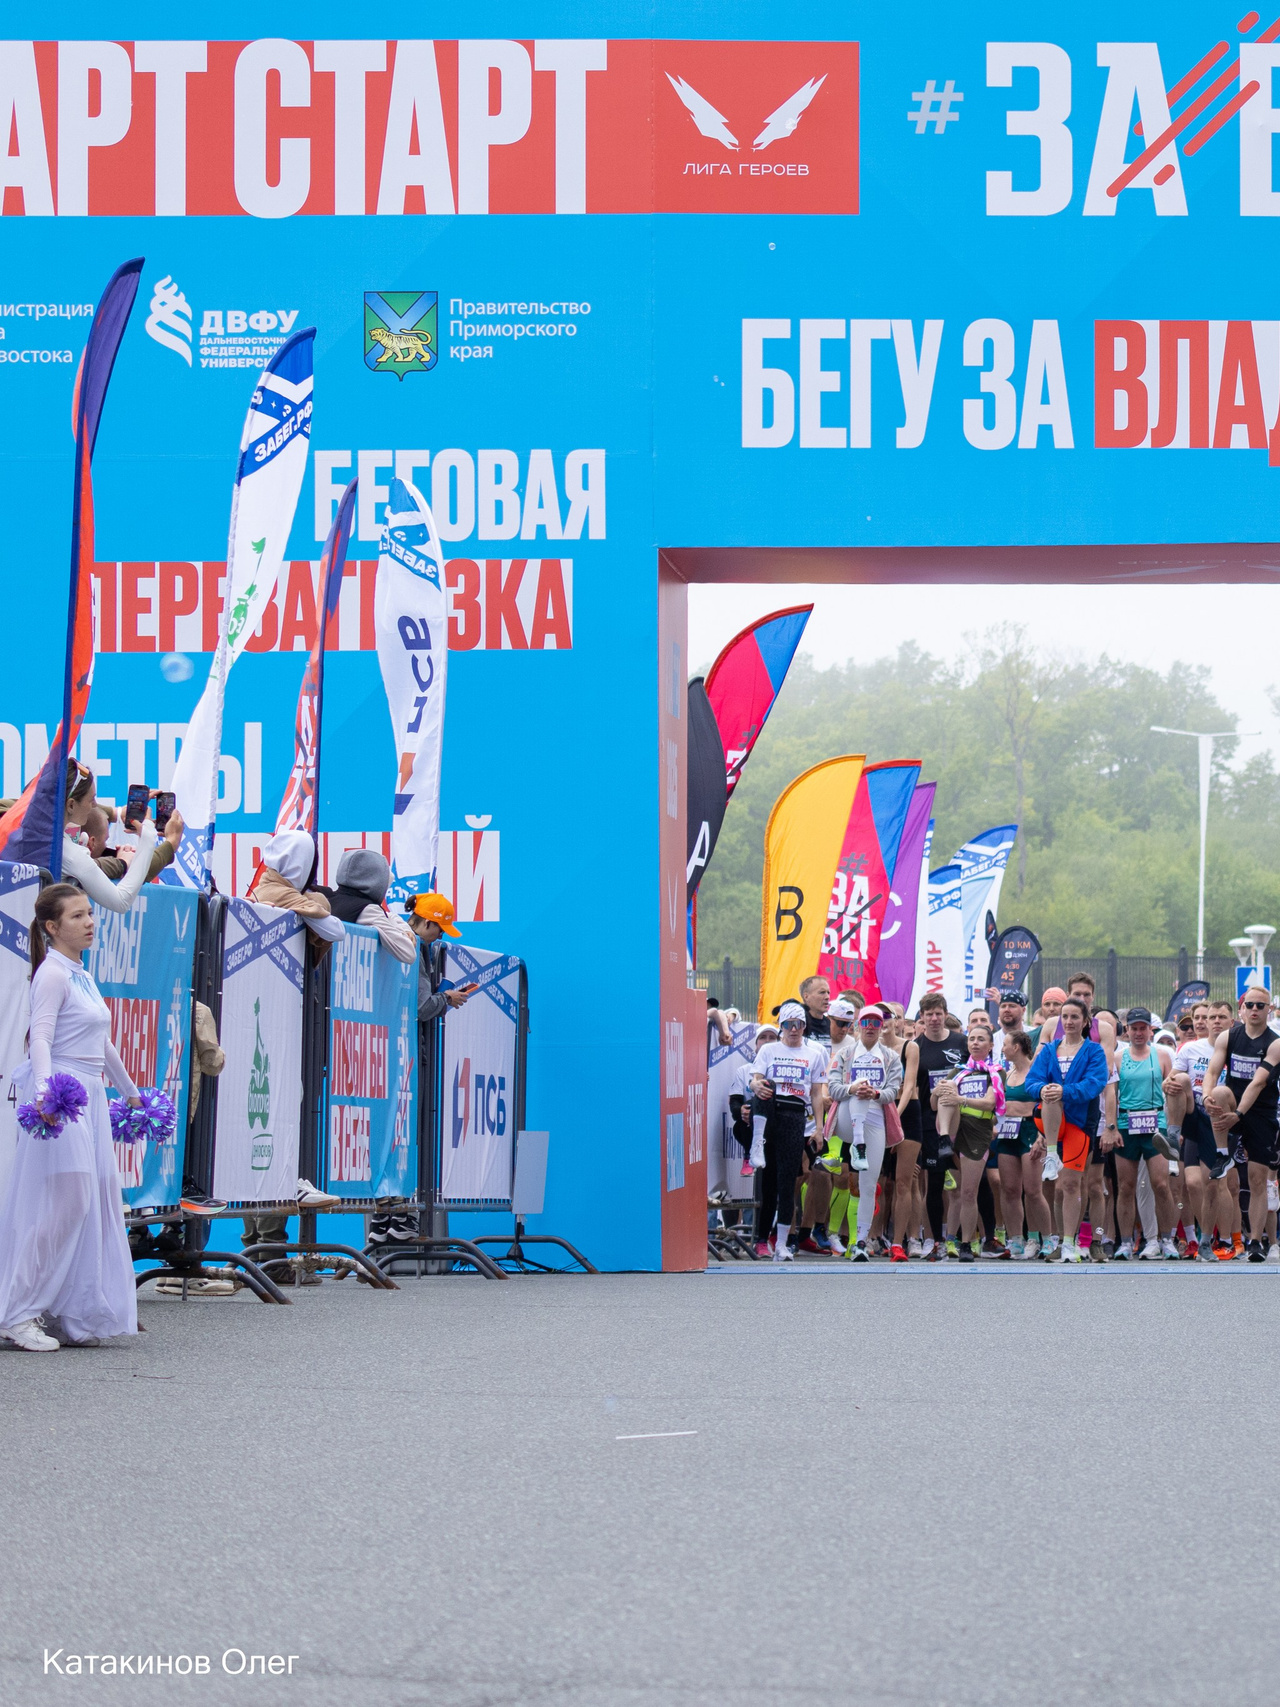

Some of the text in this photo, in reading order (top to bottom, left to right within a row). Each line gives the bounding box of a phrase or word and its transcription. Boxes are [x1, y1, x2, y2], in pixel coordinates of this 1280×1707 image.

[233, 38, 607, 218] СТАРТ
[683, 163, 810, 176] ЛИГА ГЕРОЕВ
[0, 303, 94, 320] истрация
[449, 298, 592, 319] Правительство
[200, 310, 300, 335] ДВФУ
[449, 320, 577, 341] Приморского
[200, 346, 280, 357] ФЕДЕРАЛЬН
[449, 345, 494, 362] края
[741, 318, 942, 449] БЕГУ
[962, 318, 1074, 450] ЗА
[253, 400, 313, 462] ЗАБЕГ.РФ
[928, 890, 961, 913] ЕГ.РФ
[1004, 940, 1015, 949] 10
[1000, 971, 1015, 981] 45
[369, 1024, 389, 1099] БЕГ
[776, 1066, 802, 1077] 30636
[959, 1081, 984, 1094] 30534
[474, 1073, 506, 1136] ПСБ
[1131, 1117, 1155, 1128] 30422
